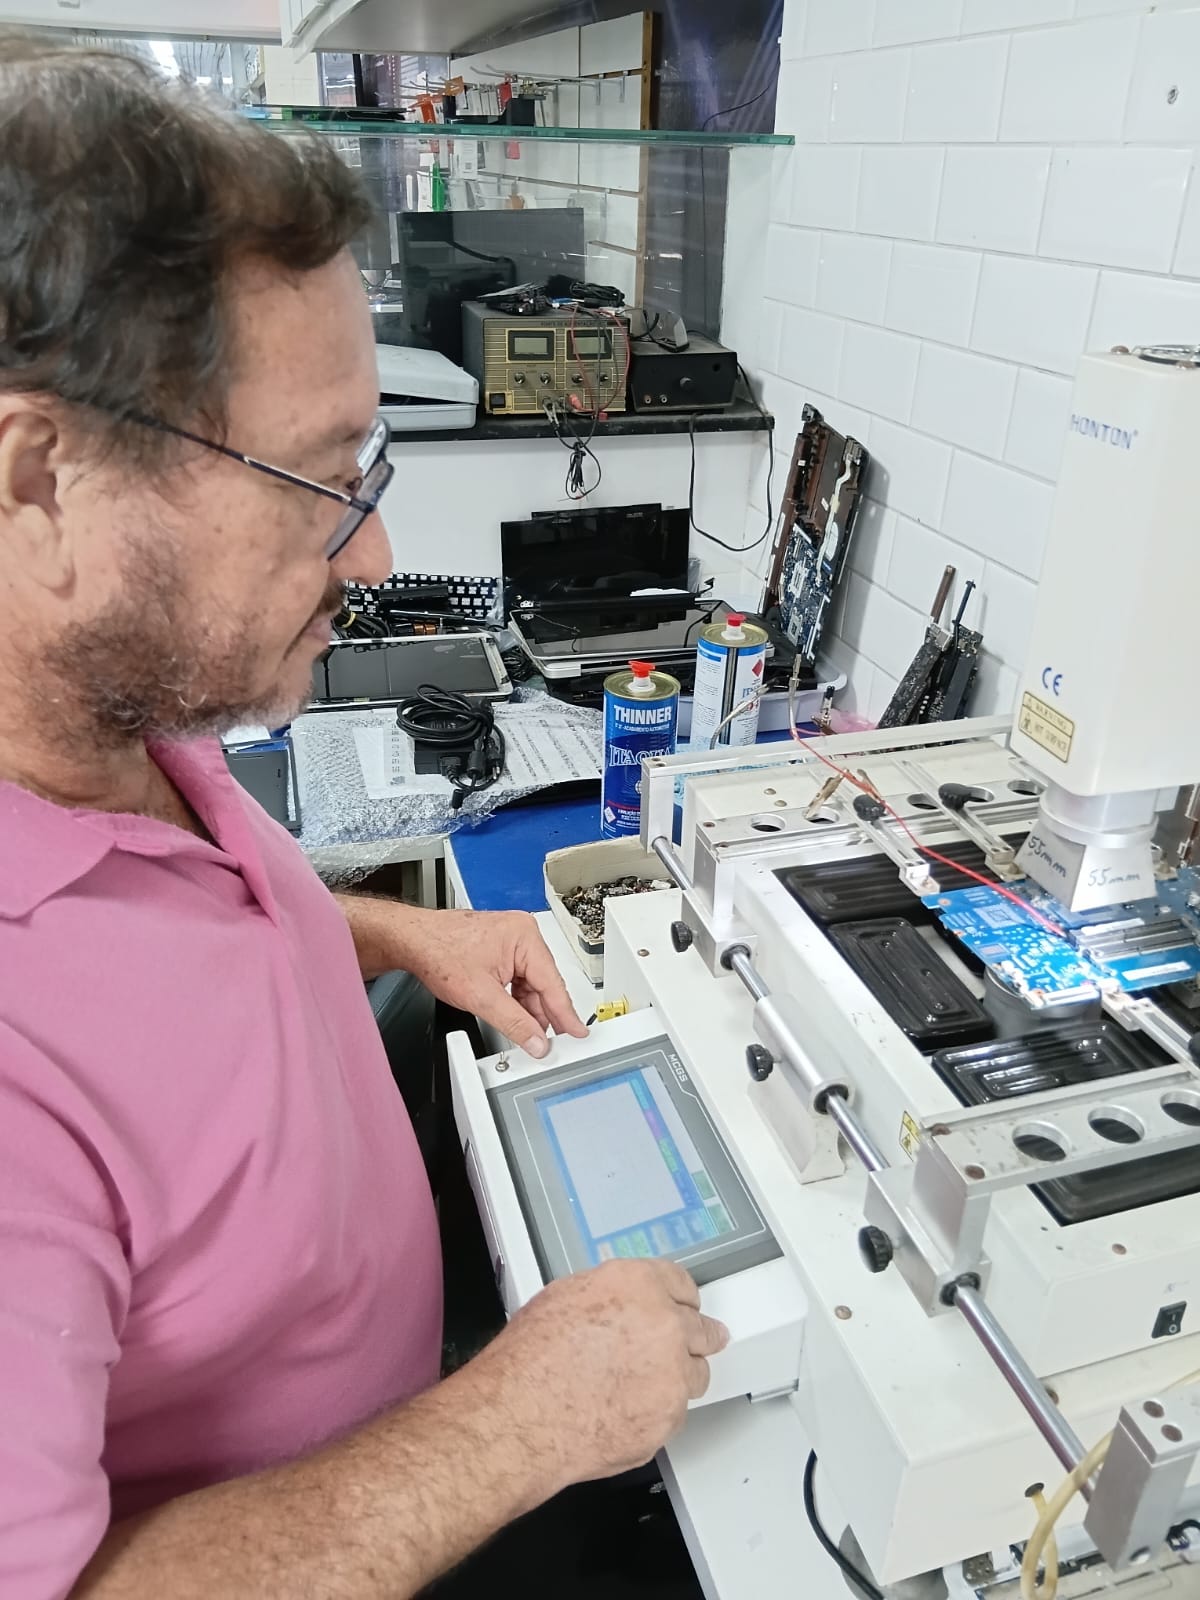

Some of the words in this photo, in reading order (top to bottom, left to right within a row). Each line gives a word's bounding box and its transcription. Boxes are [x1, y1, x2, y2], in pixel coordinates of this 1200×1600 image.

[1070, 414, 1133, 449] HONTON
[1041, 667, 1063, 696] CE
[614, 705, 672, 725] THINNER
[668, 1053, 688, 1082] MCGS
